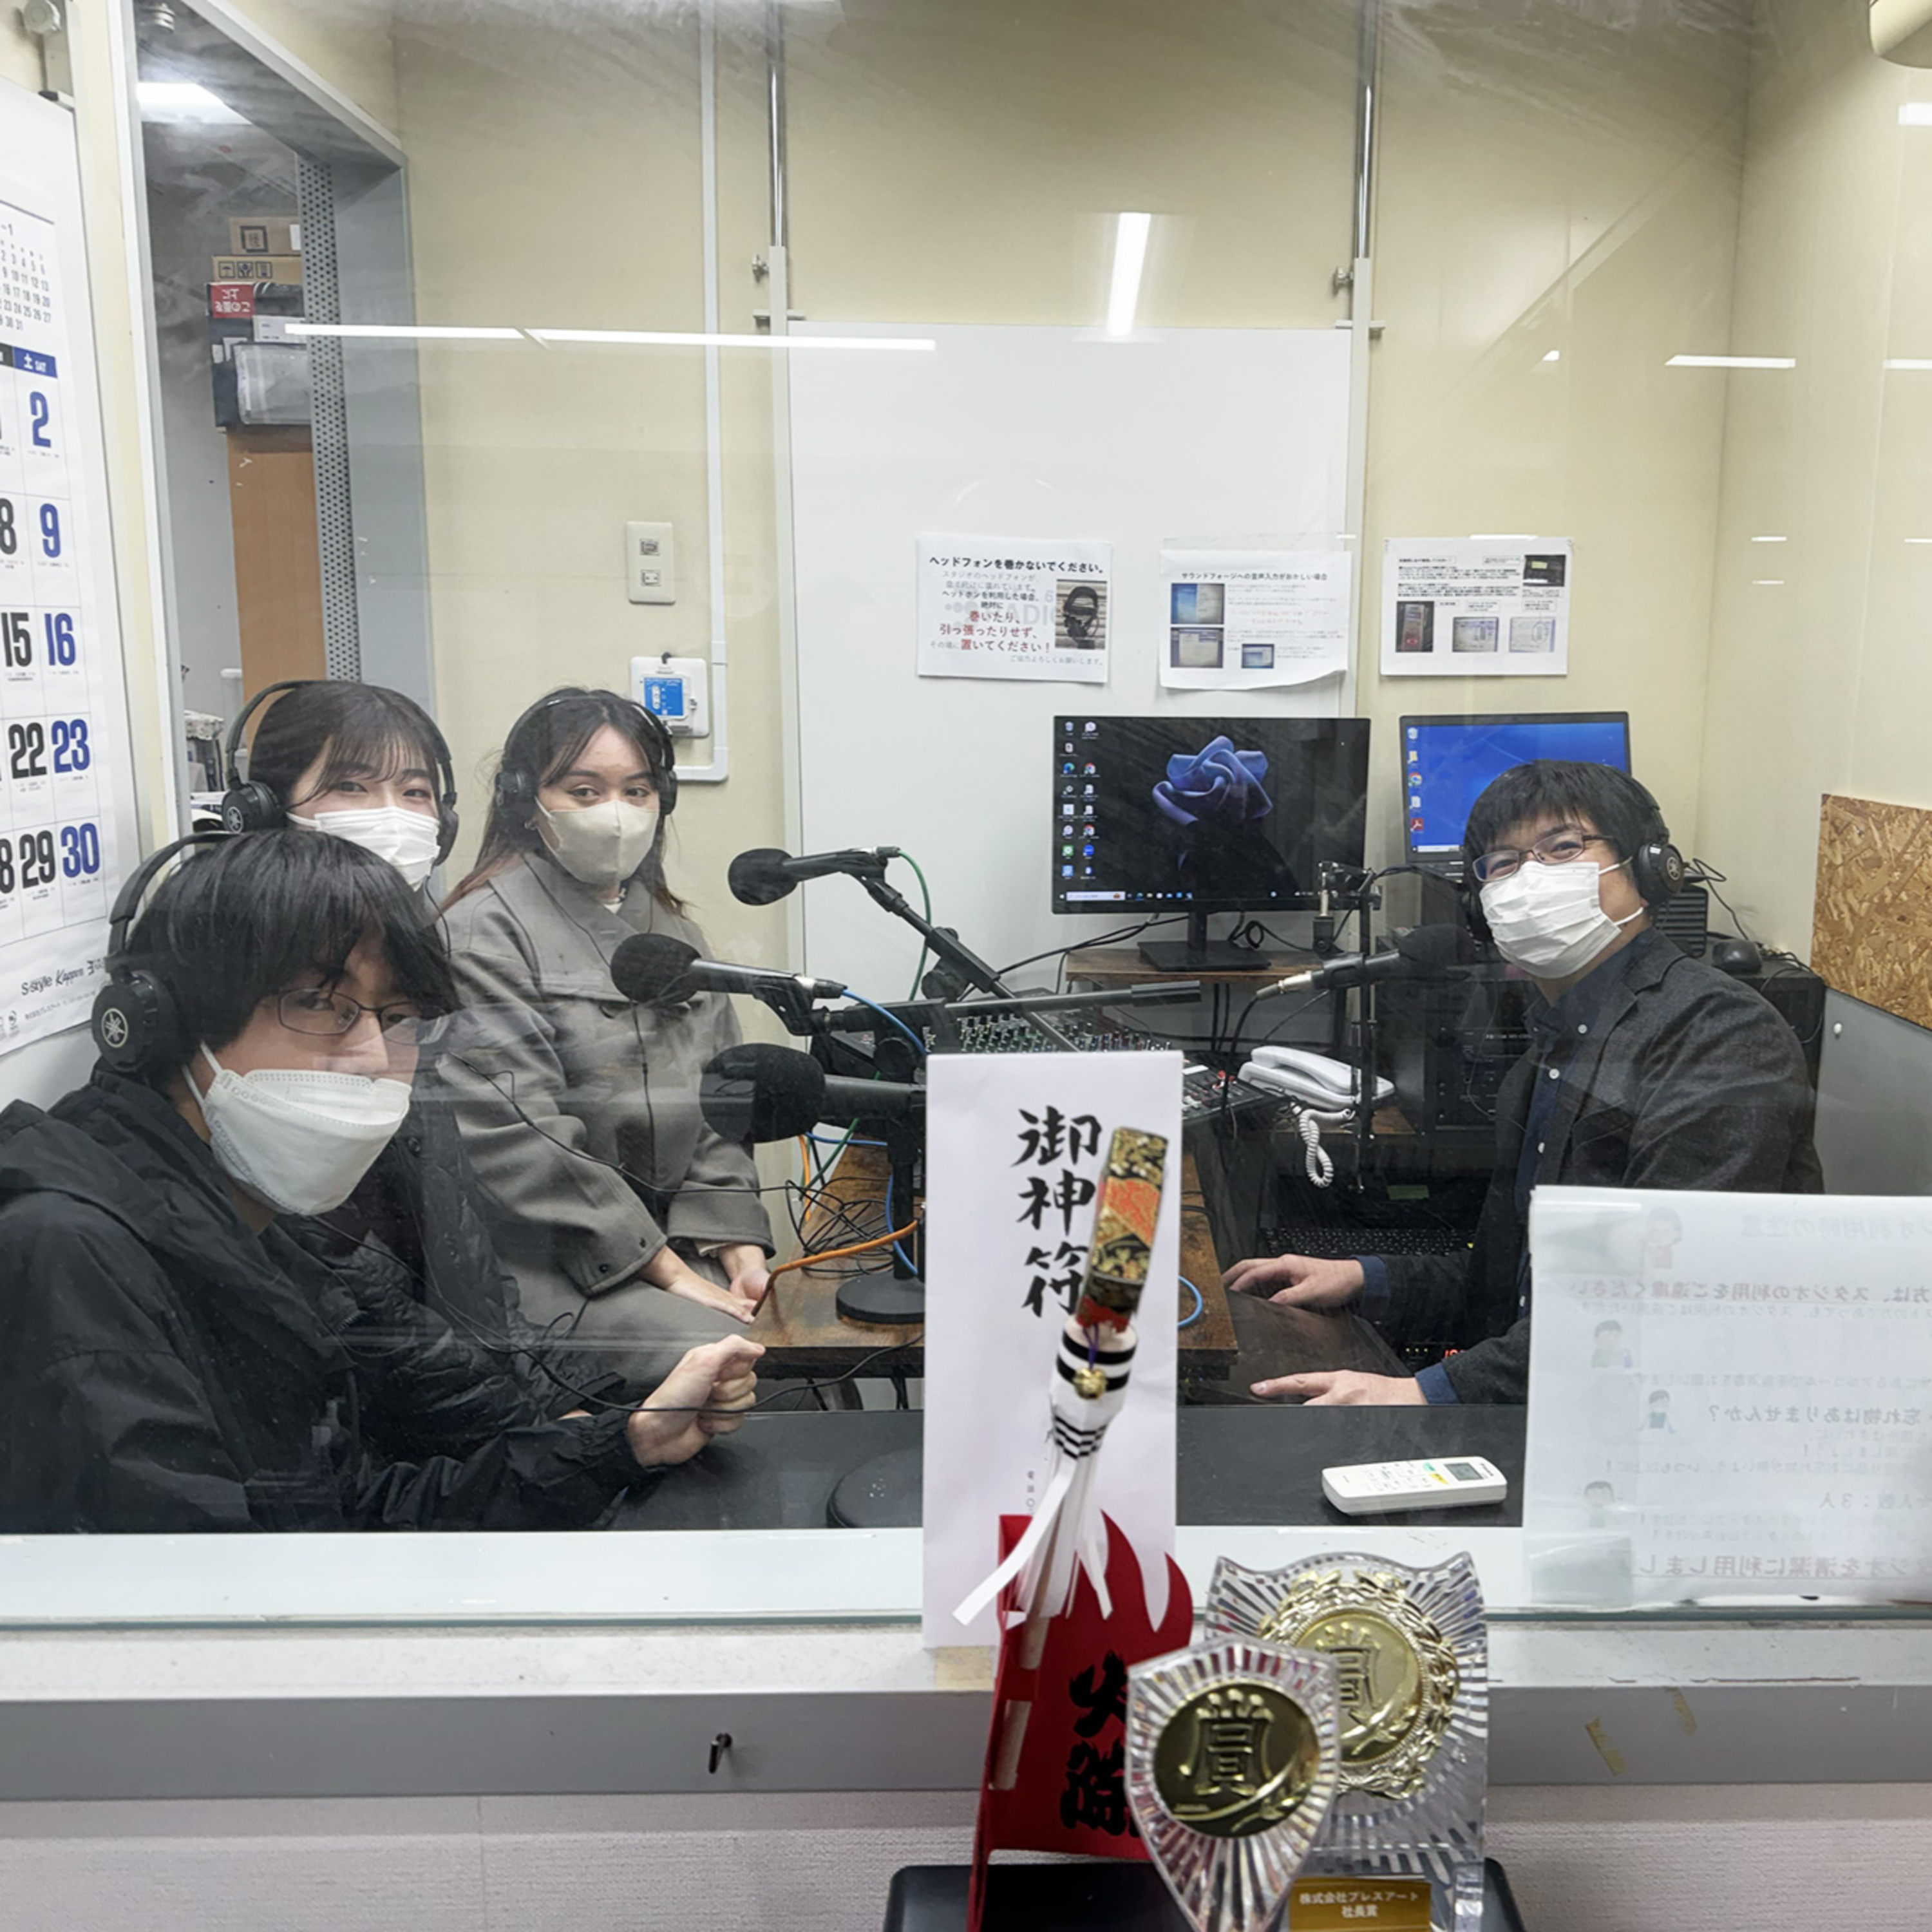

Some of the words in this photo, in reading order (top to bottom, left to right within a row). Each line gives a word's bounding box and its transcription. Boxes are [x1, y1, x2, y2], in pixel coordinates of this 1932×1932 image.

[11, 270, 19, 281] 10
[21, 273, 28, 285] 11
[31, 276, 38, 288] 12
[41, 279, 49, 292] 13
[13, 287, 20, 298] 17
[23, 290, 30, 301] 18
[33, 294, 41, 305] 19
[42, 296, 50, 308] 20
[4, 299, 12, 311] 23
[14, 302, 22, 314] 24
[23, 305, 32, 317] 25
[33, 308, 42, 321] 26
[43, 311, 51, 323] 27
[24, 353, 33, 369] 土
[35, 360, 46, 372] SAT
[30, 391, 52, 448] 2
[40, 504, 61, 558] 9
[929, 556, 1103, 574] ヘッドフォンを巻かないでください。
[969, 611, 1020, 625] 巻いたり、
[1, 612, 33, 667] 15
[44, 612, 76, 667] 16
[940, 623, 1037, 639] 引っ張ったりせず、
[8, 722, 47, 779] 22
[51, 719, 91, 773] 23
[19, 829, 57, 889] 29
[60, 822, 99, 878] 30
[1011, 1105, 1102, 1318] 御神符
[1179, 1688, 1274, 1797] 賞
[1299, 1891, 1419, 1905] 株式会社プレスアート
[1341, 1904, 1379, 1919] 社長賞
